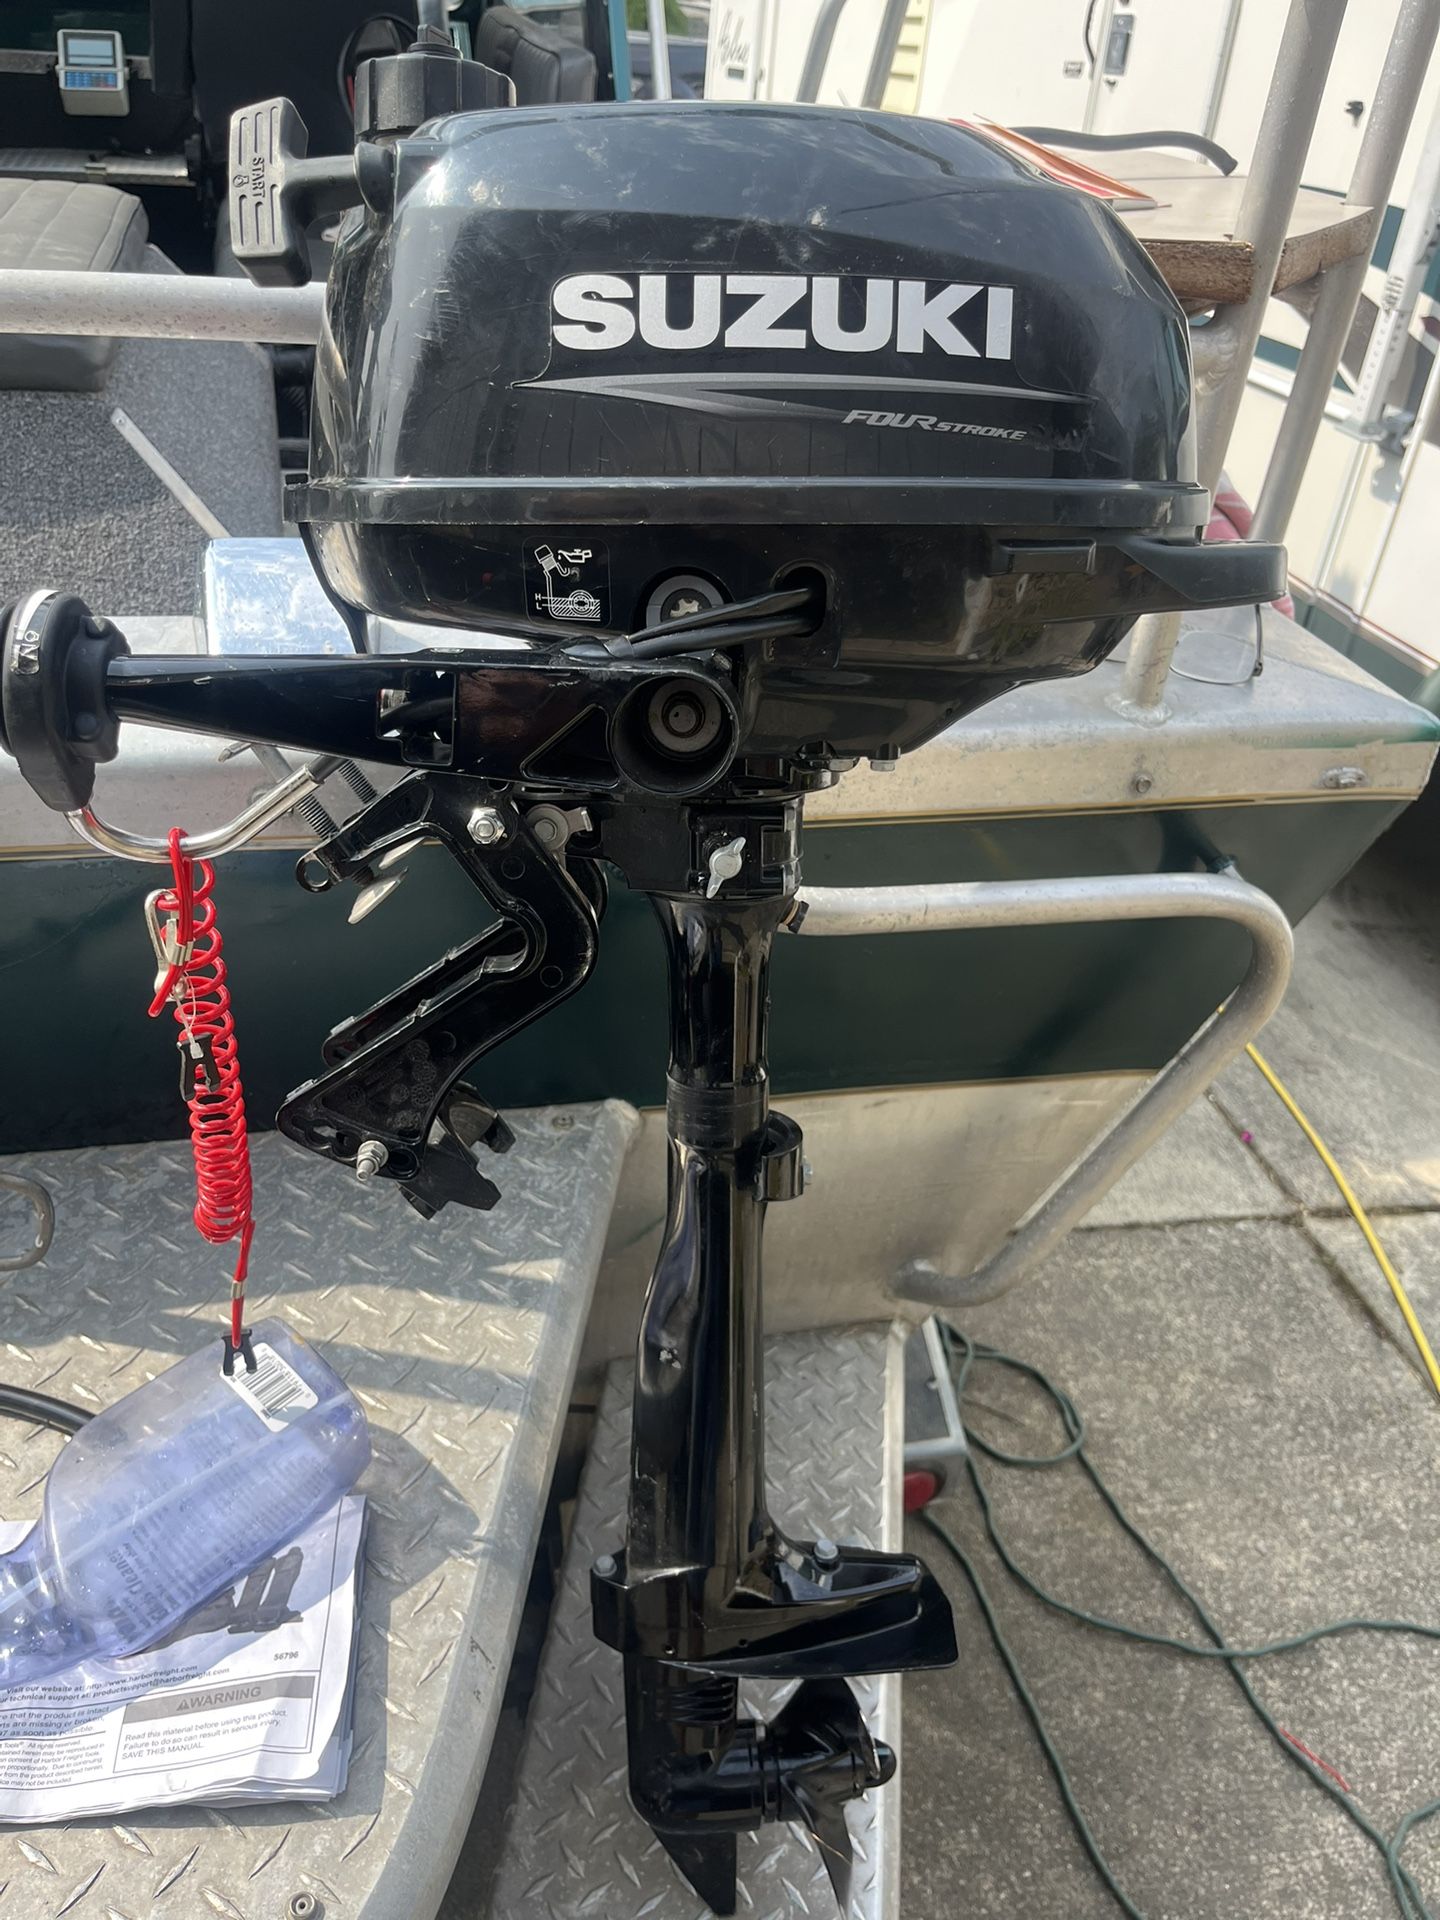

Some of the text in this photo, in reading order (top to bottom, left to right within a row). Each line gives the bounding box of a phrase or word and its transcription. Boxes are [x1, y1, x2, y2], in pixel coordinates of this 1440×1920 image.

[252, 157, 266, 198] START
[551, 274, 1015, 361] SUZUKI
[841, 409, 1029, 441] FOUR STROKE
[534, 592, 542, 601] H
[535, 602, 542, 610] L
[273, 1650, 300, 1661] 56796
[6, 1686, 24, 1695] Visit
[41, 1684, 72, 1693] website
[9, 1694, 46, 1702] technical
[48, 1692, 80, 1702] support
[190, 1686, 262, 1708] WARNING
[9, 1711, 27, 1720] that
[28, 1711, 42, 1719] the
[43, 1710, 77, 1721] product
[86, 1706, 110, 1716] intact
[28, 1719, 63, 1730] missing
[125, 1731, 146, 1742] Read
[147, 1730, 161, 1739] this
[162, 1724, 194, 1736] material
[194, 1720, 220, 1731] before
[220, 1717, 241, 1727] using
[242, 1713, 257, 1722] this
[123, 1741, 150, 1752] Failure
[151, 1740, 160, 1748] to
[160, 1738, 171, 1746] do
[172, 1737, 182, 1745] so
[183, 1735, 198, 1743] can
[198, 1729, 221, 1739] result
[222, 1727, 230, 1735] in
[230, 1722, 258, 1734] serious
[121, 1749, 144, 1760] SAVE
[145, 1747, 166, 1757] THIS
